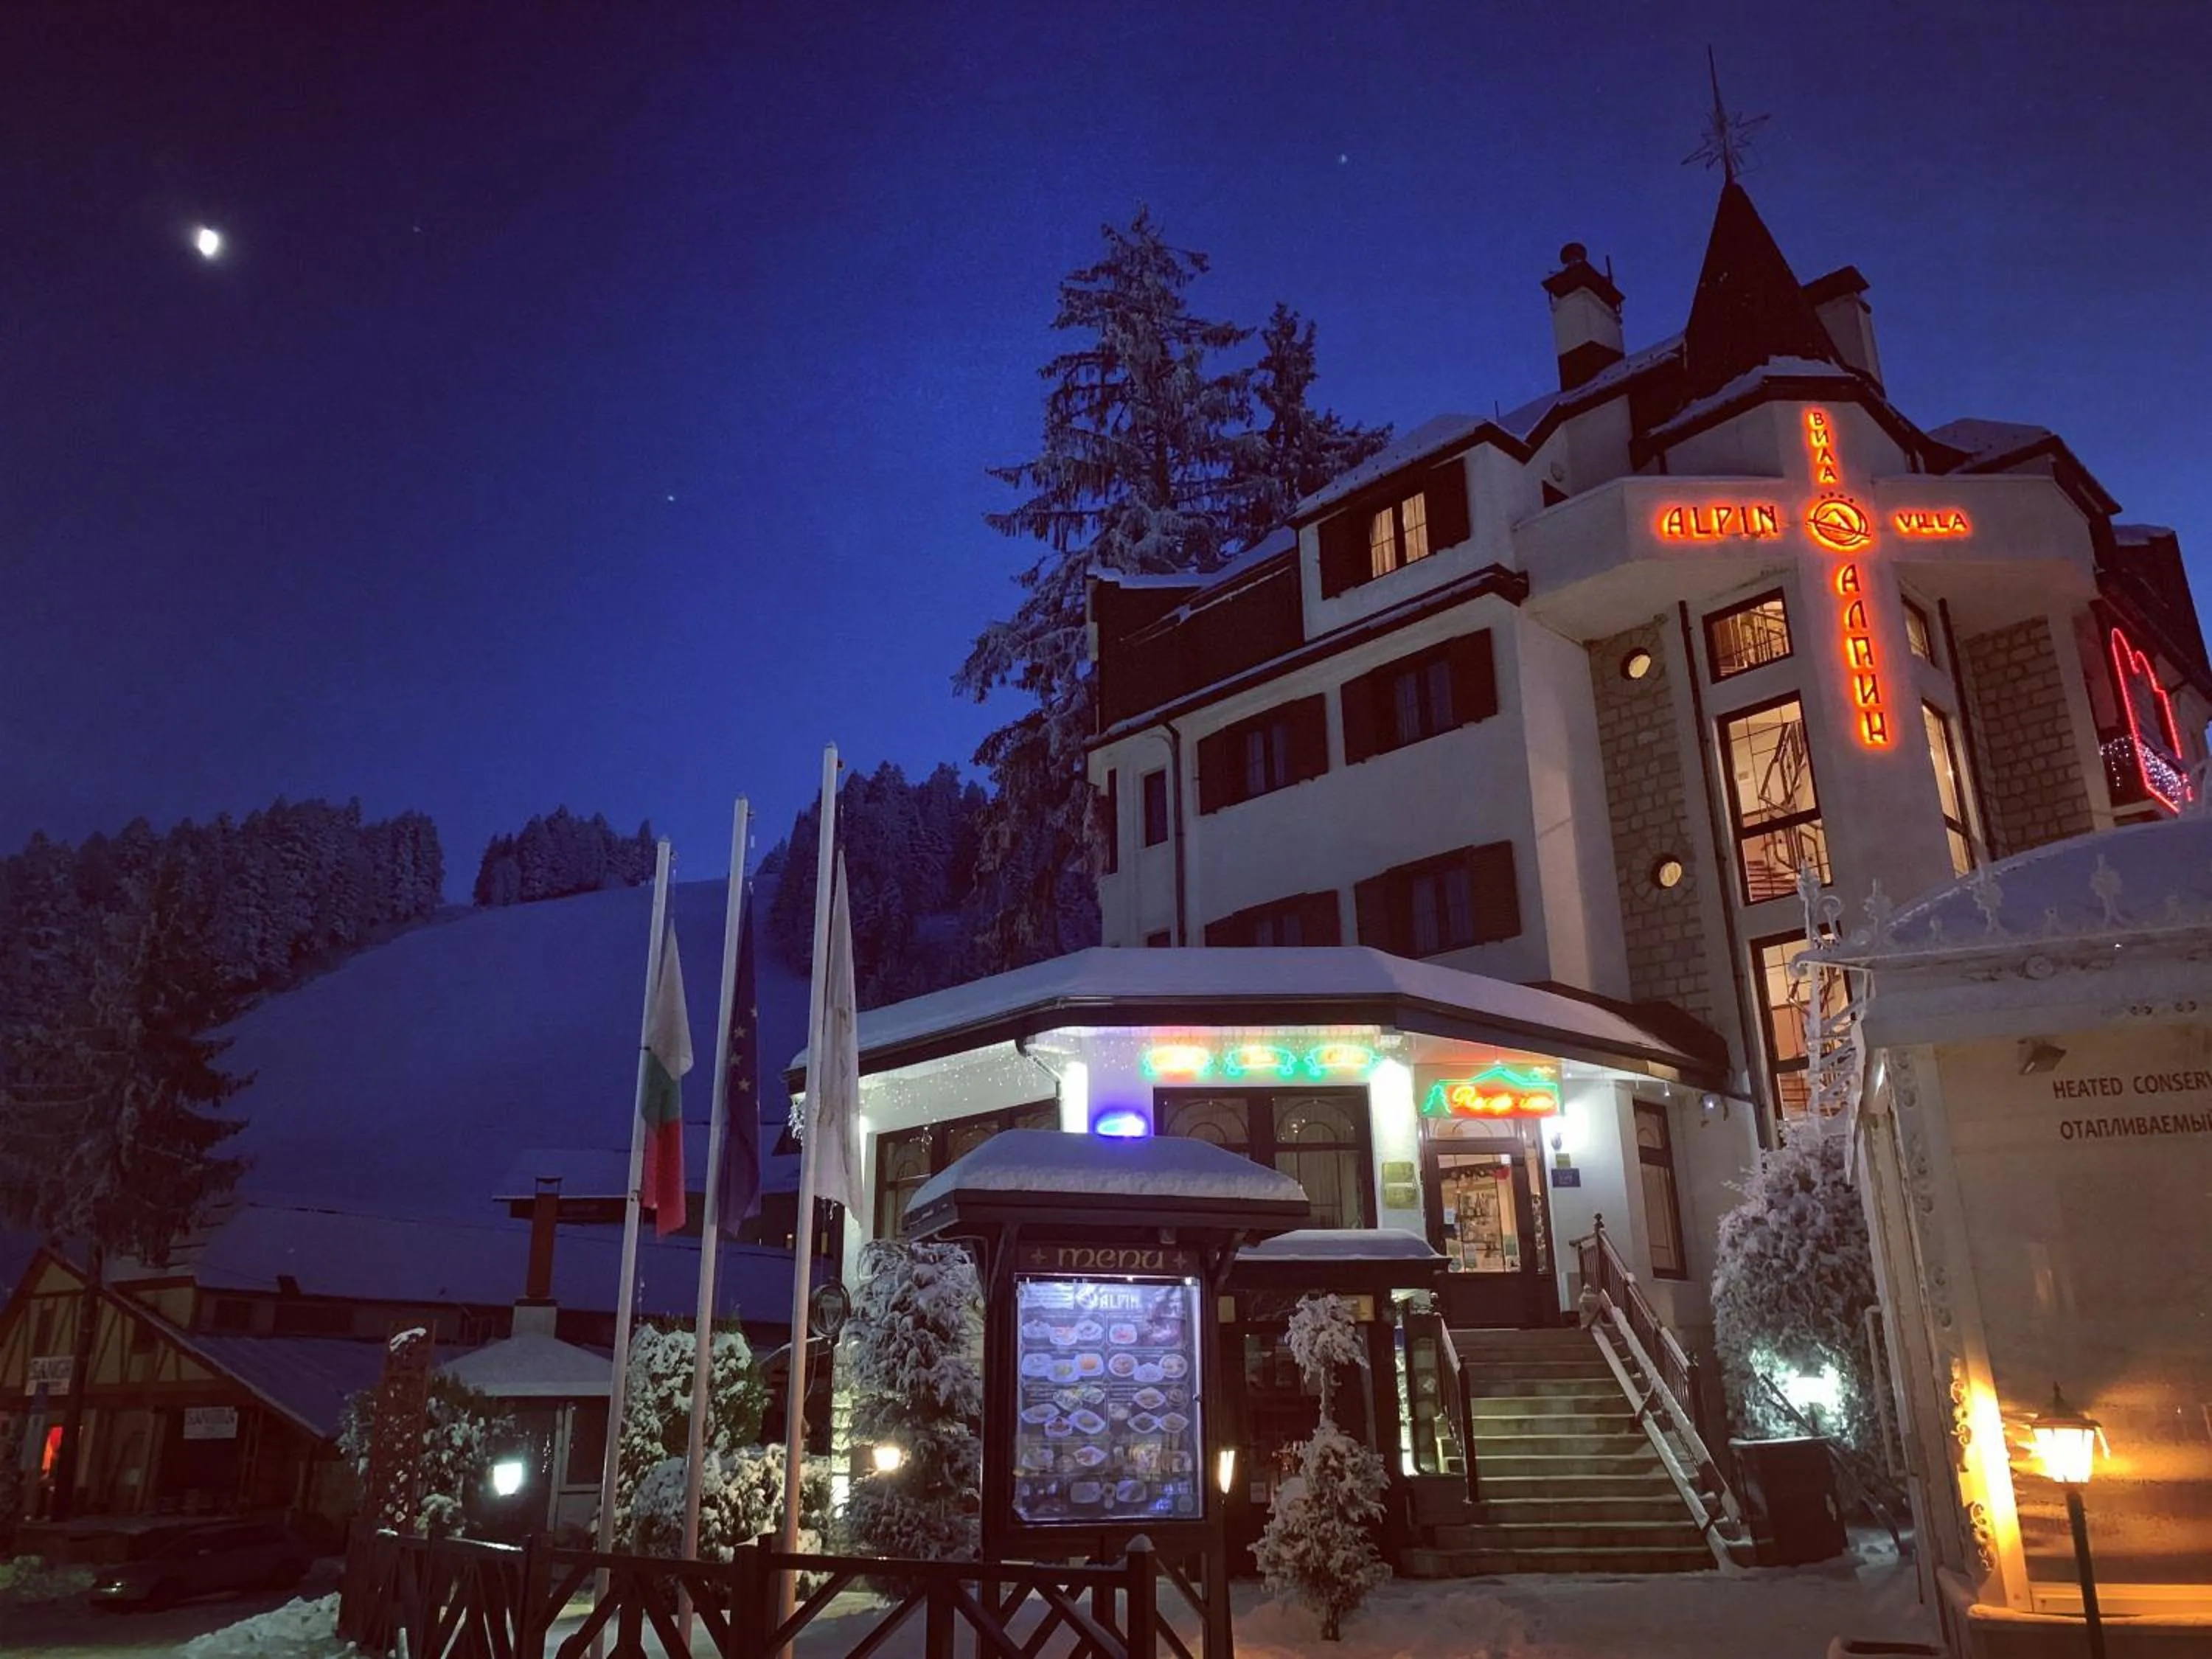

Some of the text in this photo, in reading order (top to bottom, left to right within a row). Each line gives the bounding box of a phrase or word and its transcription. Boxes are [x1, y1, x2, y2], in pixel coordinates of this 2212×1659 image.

[1809, 411, 1837, 481] ВИЛА
[1663, 505, 1969, 535] ALPIN VILLA
[1841, 563, 1888, 743] АЛПИН
[2052, 1077, 2124, 1099] HEATED
[1057, 1247, 1164, 1270] menu
